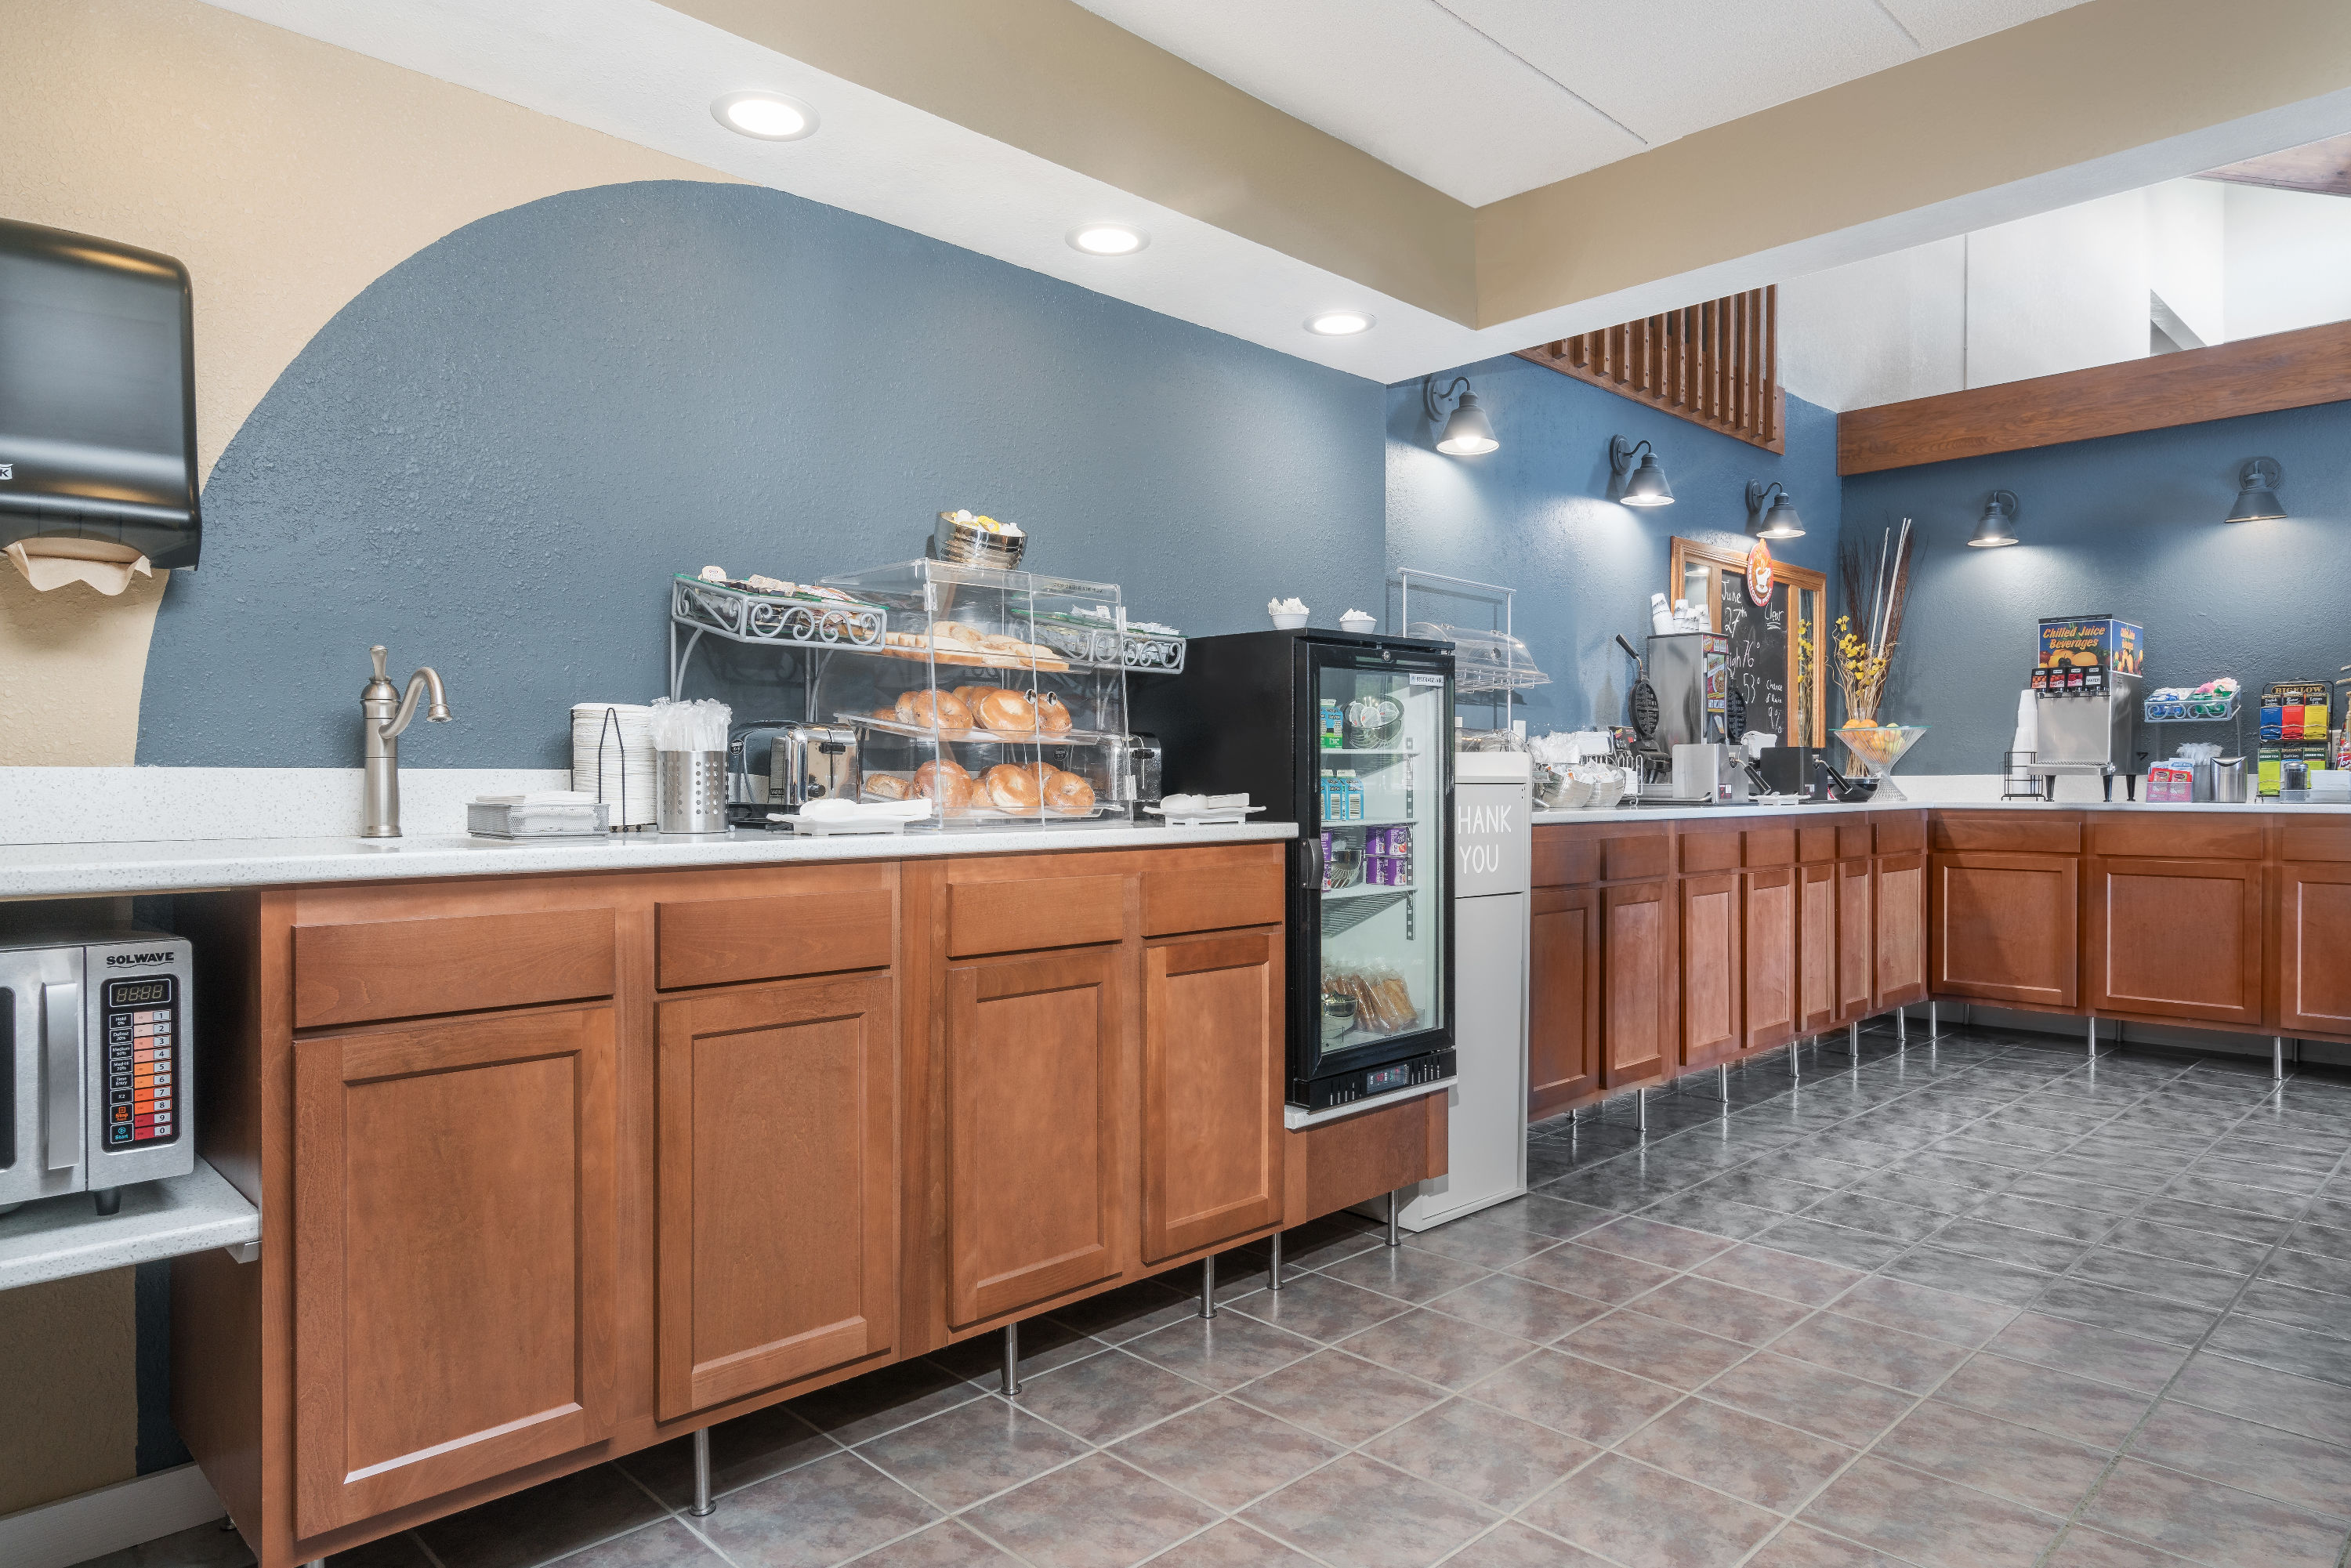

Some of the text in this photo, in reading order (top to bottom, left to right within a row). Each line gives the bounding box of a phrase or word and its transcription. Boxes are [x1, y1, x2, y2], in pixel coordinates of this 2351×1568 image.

[1722, 579, 1742, 603] June
[1764, 603, 1784, 621] Clear
[2043, 627, 2078, 639] Chilled
[2078, 626, 2106, 637] Juice
[2049, 638, 2099, 650] Beverages
[1766, 679, 1783, 691] Chance
[1458, 805, 1512, 835] HANK
[1459, 844, 1498, 874] YOU
[106, 952, 174, 965] SOLWAVE
